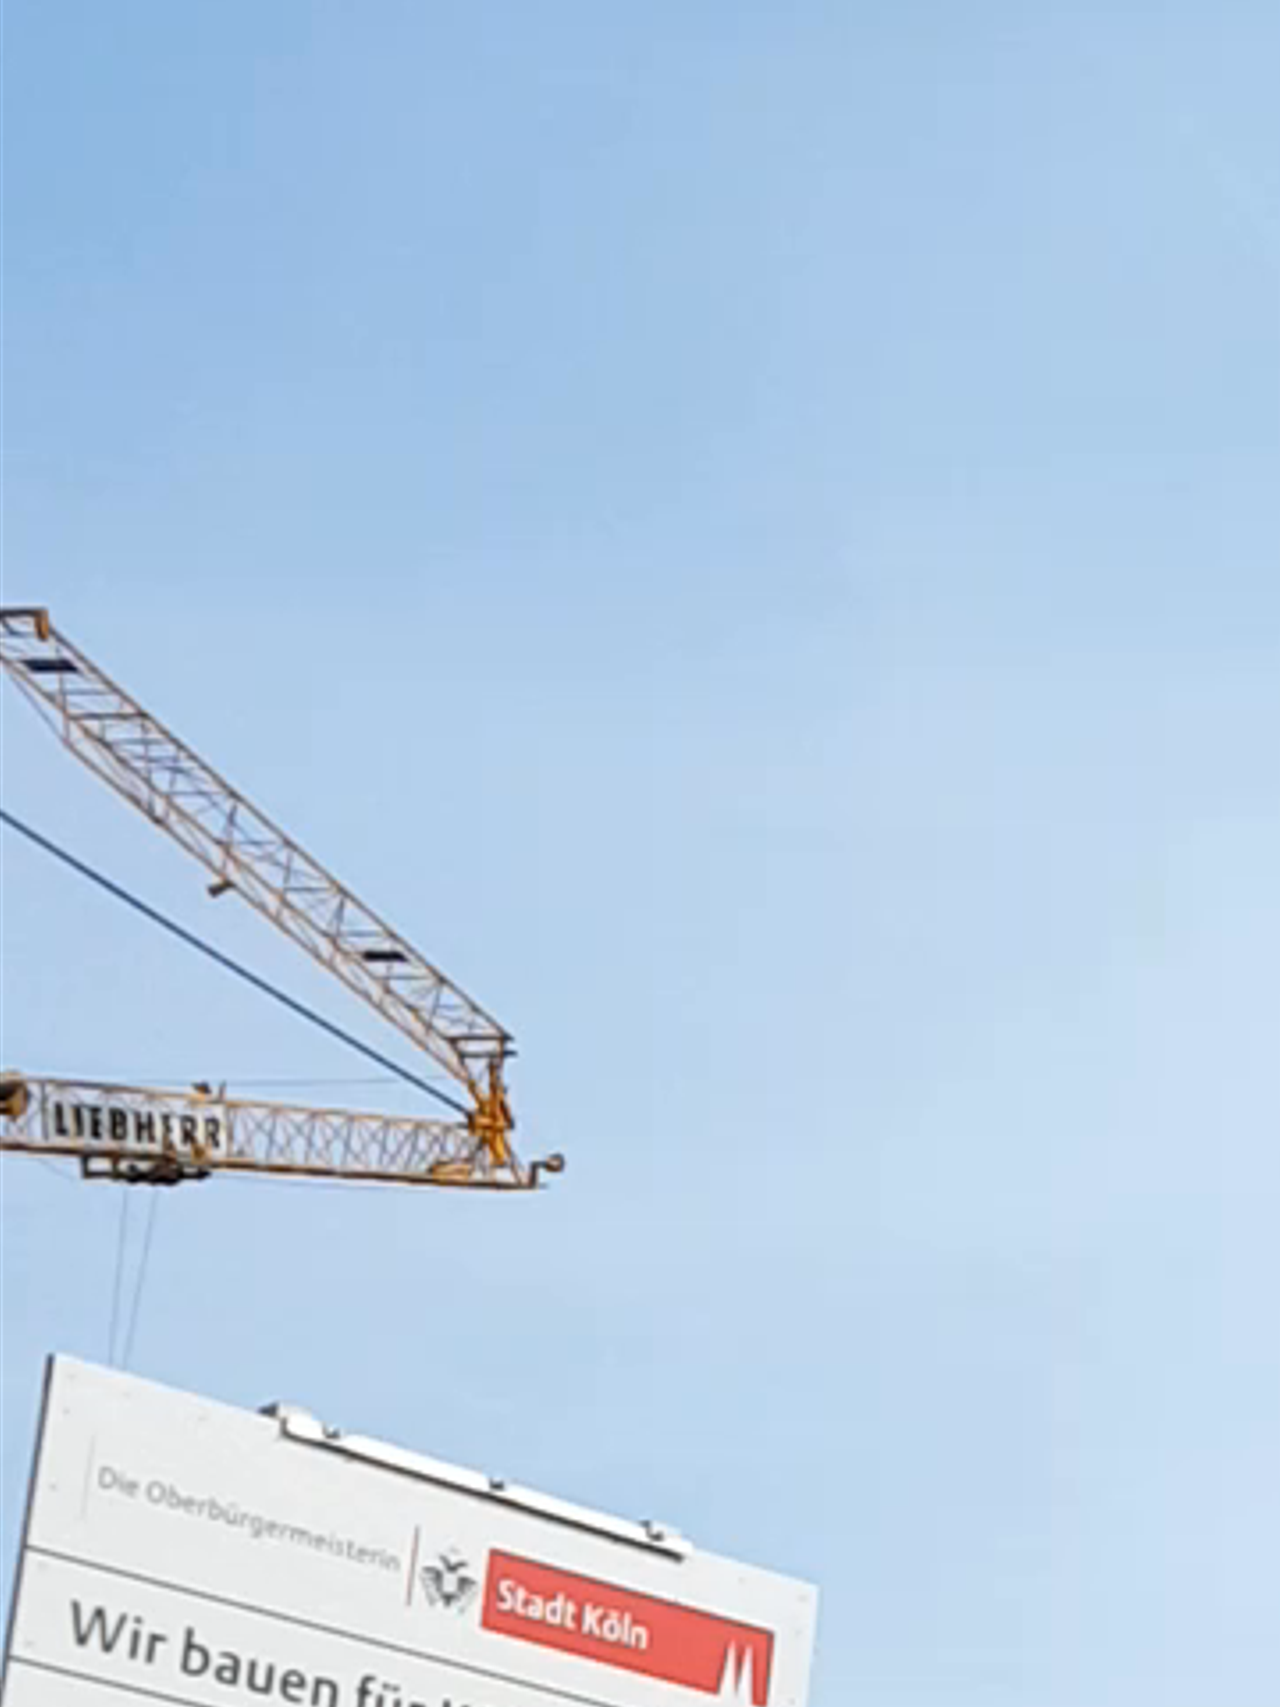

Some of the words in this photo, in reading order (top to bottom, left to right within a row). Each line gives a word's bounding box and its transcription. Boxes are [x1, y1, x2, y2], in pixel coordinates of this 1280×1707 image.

[54, 1101, 221, 1149] LIEBHERR
[96, 1464, 140, 1502] Die
[144, 1478, 402, 1577] Oberbürgermeisterin
[66, 1596, 169, 1668] Wir
[496, 1576, 577, 1630] Stadt
[581, 1600, 649, 1651] Köln
